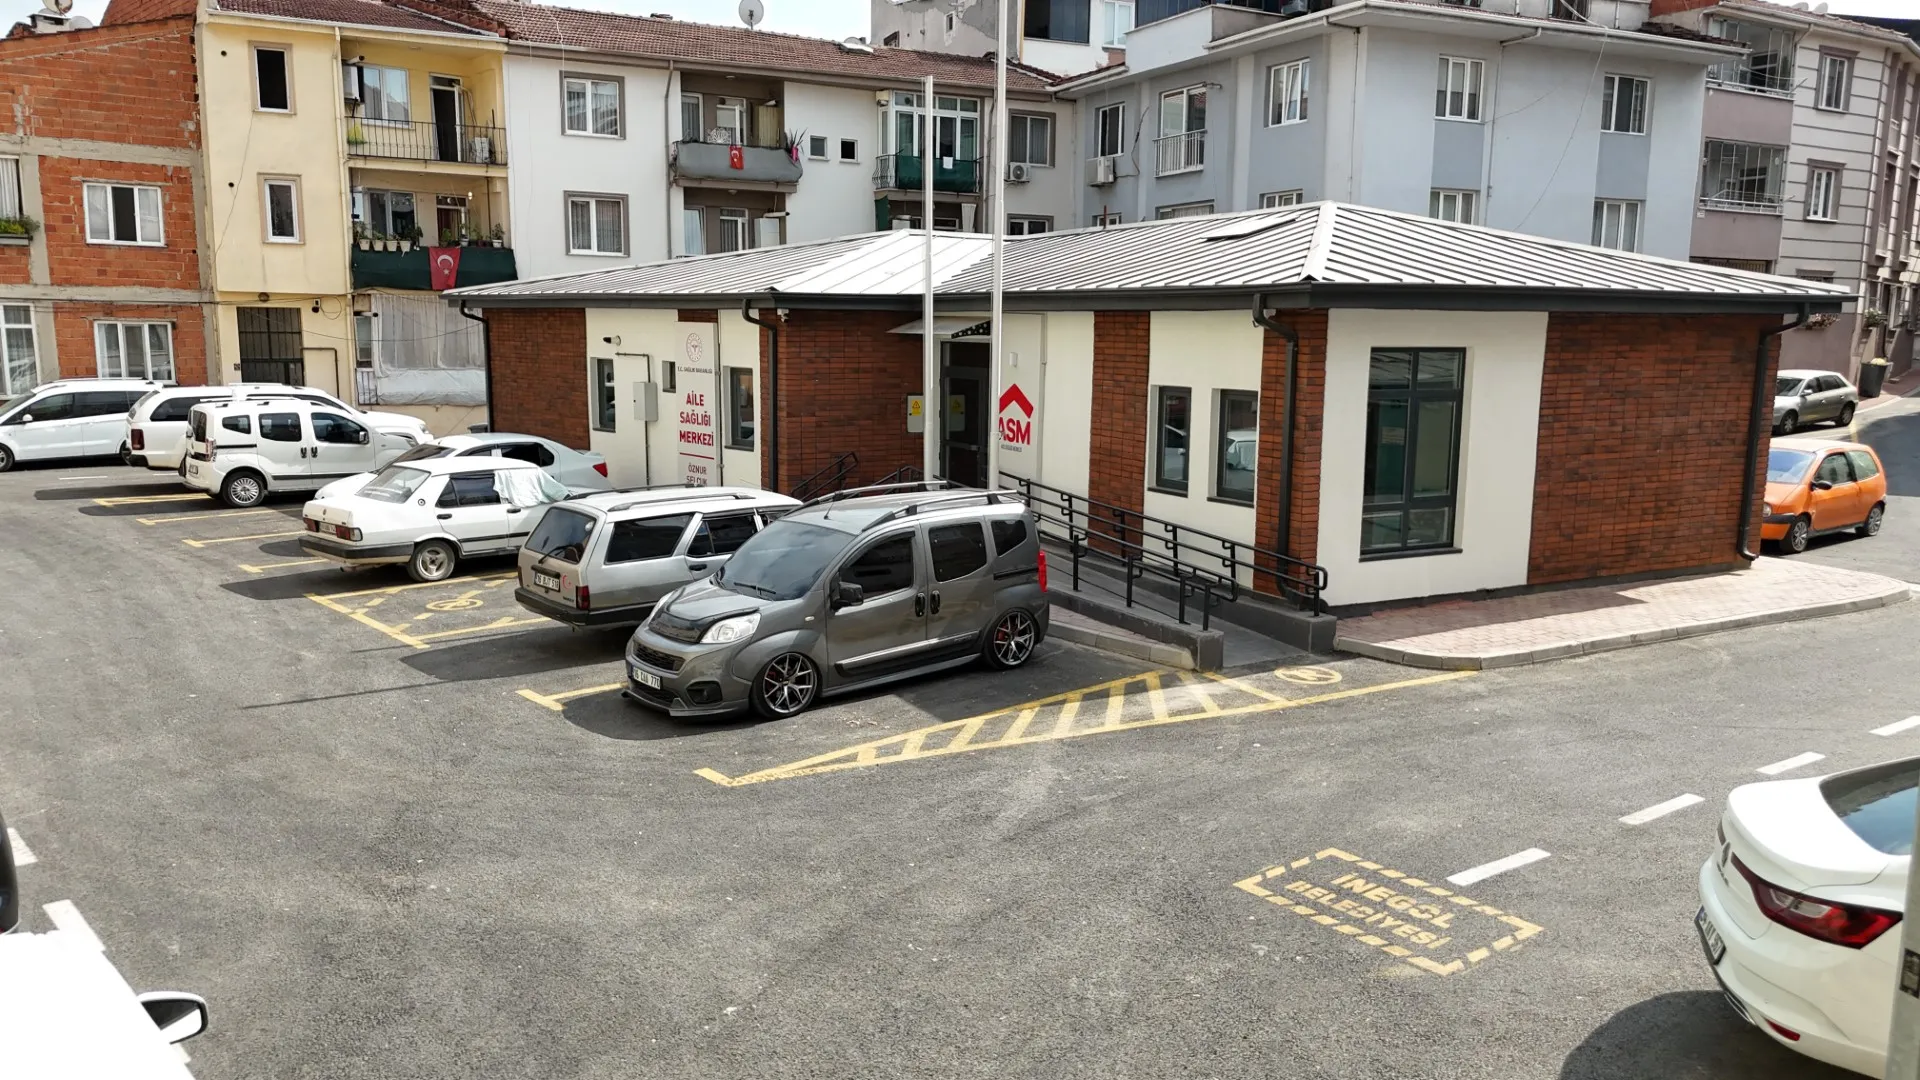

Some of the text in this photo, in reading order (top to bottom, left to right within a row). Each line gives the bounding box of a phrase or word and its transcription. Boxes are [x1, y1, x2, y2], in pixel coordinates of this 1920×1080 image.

[686, 390, 705, 407] AİLE
[680, 409, 711, 427] SAĞLIĞI
[679, 430, 714, 447] MERKEZİ
[998, 416, 1031, 445] ASM
[688, 462, 707, 475] ÖZNUR
